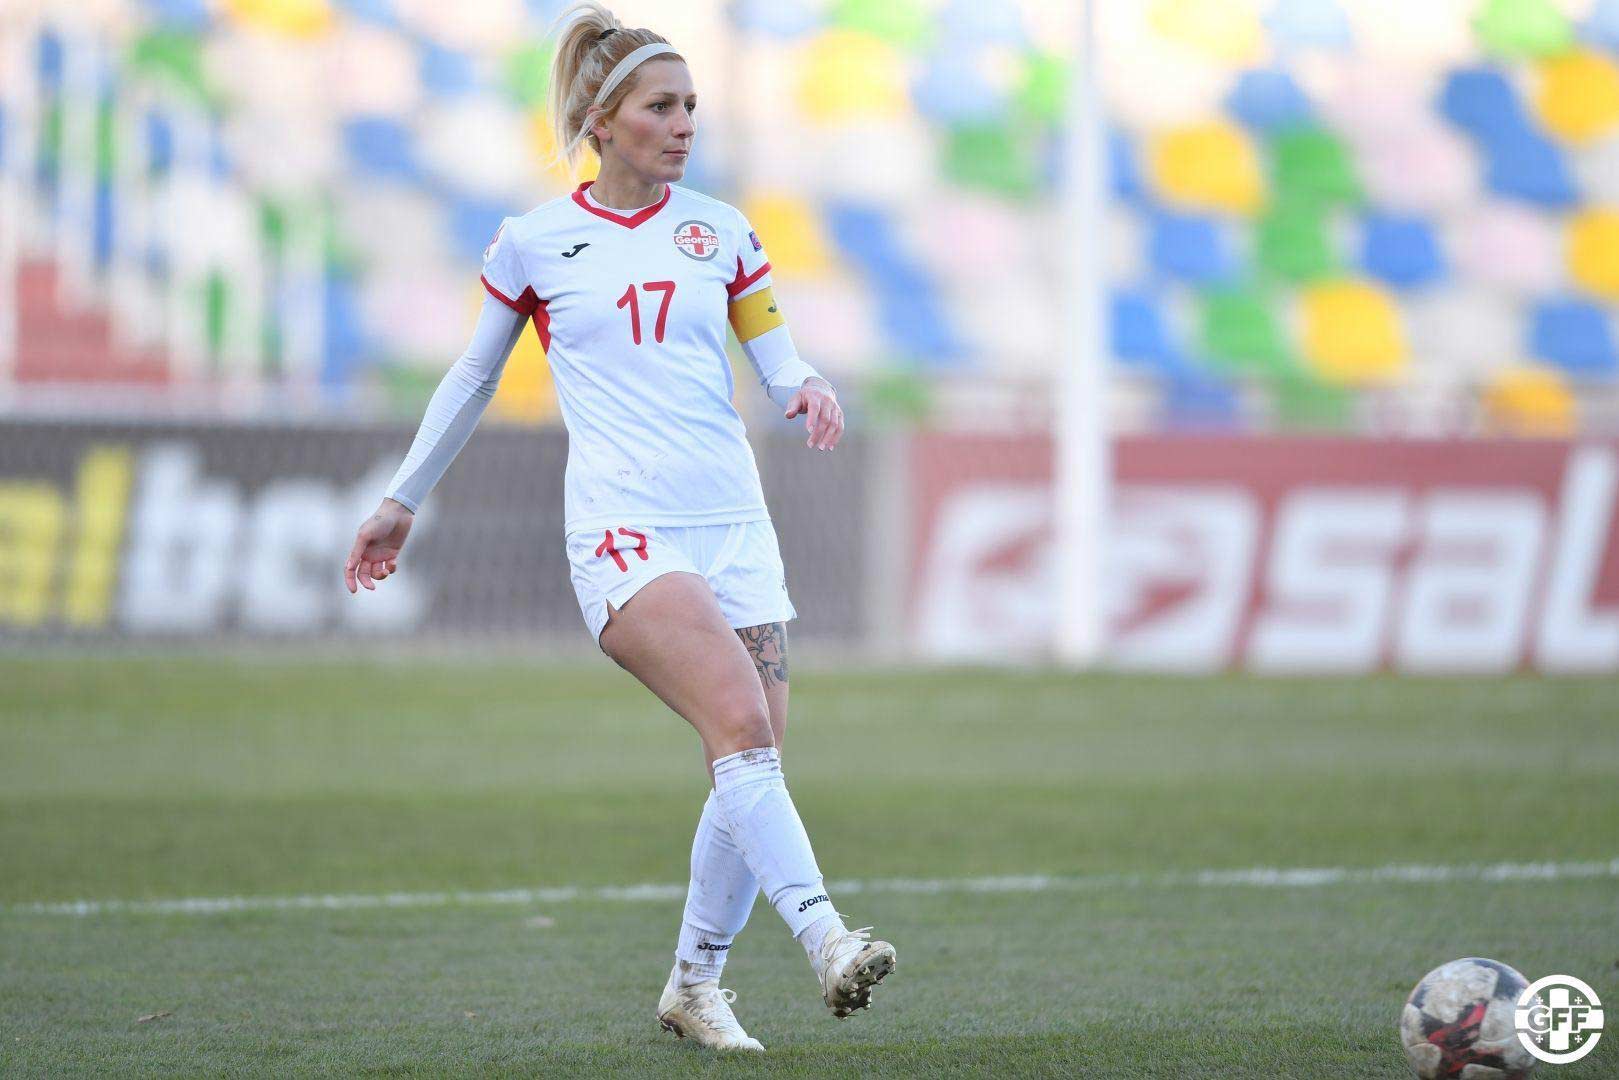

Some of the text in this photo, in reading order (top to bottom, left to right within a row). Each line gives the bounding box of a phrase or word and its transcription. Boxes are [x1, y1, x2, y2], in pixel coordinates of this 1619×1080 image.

[675, 234, 719, 246] Georgia
[616, 280, 676, 346] 17
[595, 527, 649, 573] 17
